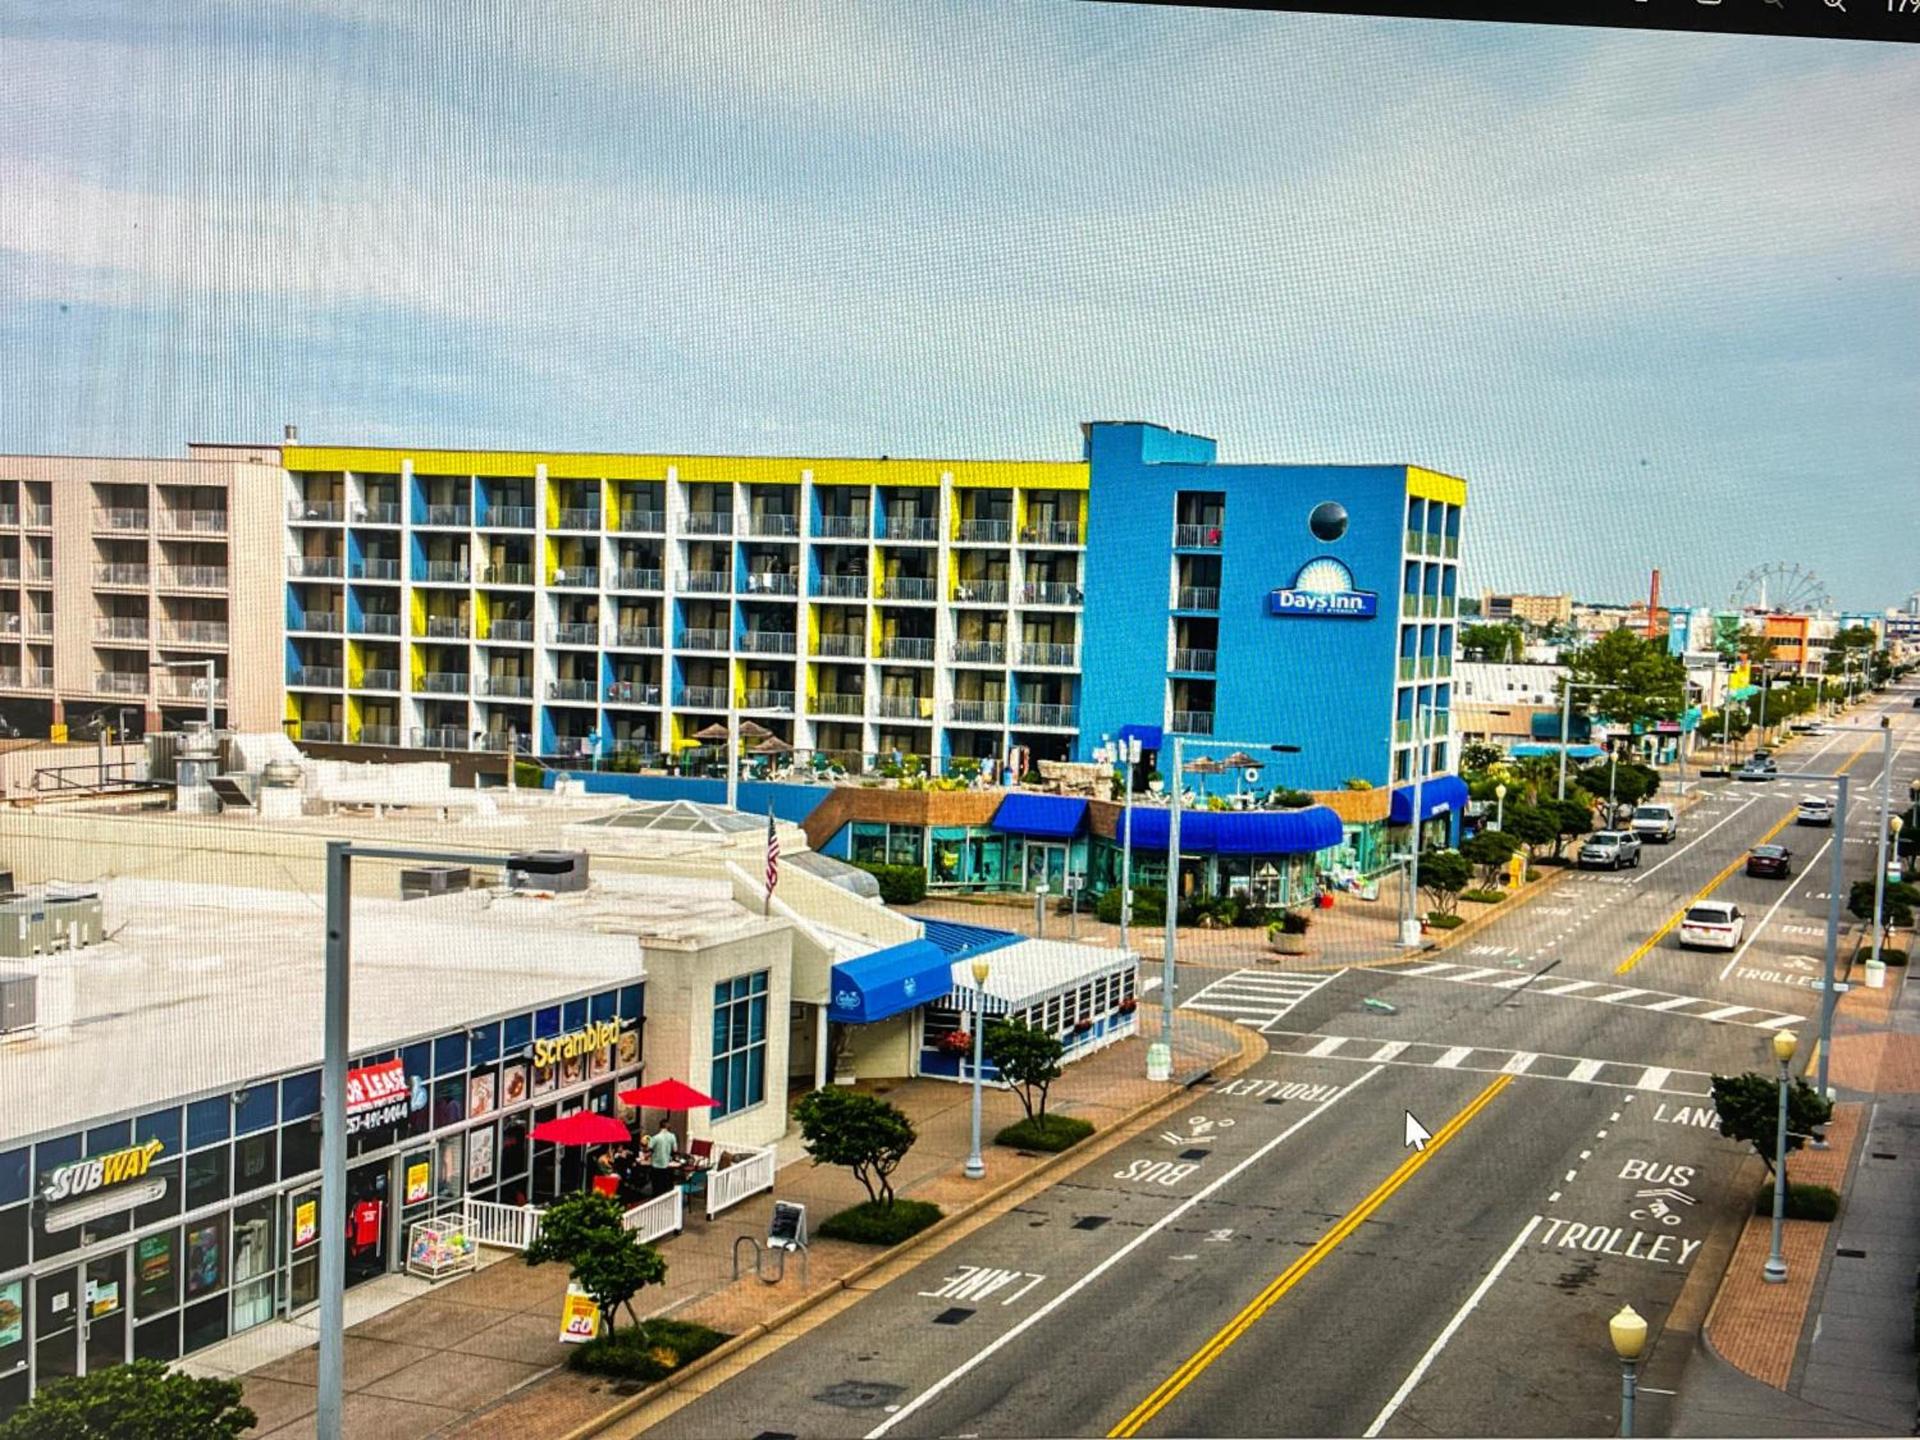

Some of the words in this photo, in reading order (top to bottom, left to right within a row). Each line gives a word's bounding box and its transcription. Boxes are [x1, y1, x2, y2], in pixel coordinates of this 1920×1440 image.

[1280, 591, 1328, 610] Days
[1330, 594, 1363, 609] Inn
[534, 1015, 622, 1069] Scrambled
[361, 1067, 407, 1099] LEASE
[1217, 1078, 1345, 1102] TROLLEY
[43, 1139, 165, 1202] SUBWAY
[1114, 1159, 1200, 1186] BUS
[1618, 1158, 1695, 1187] BUS
[1540, 1217, 1702, 1265] TROLLEY
[918, 1265, 1047, 1306] LANE
